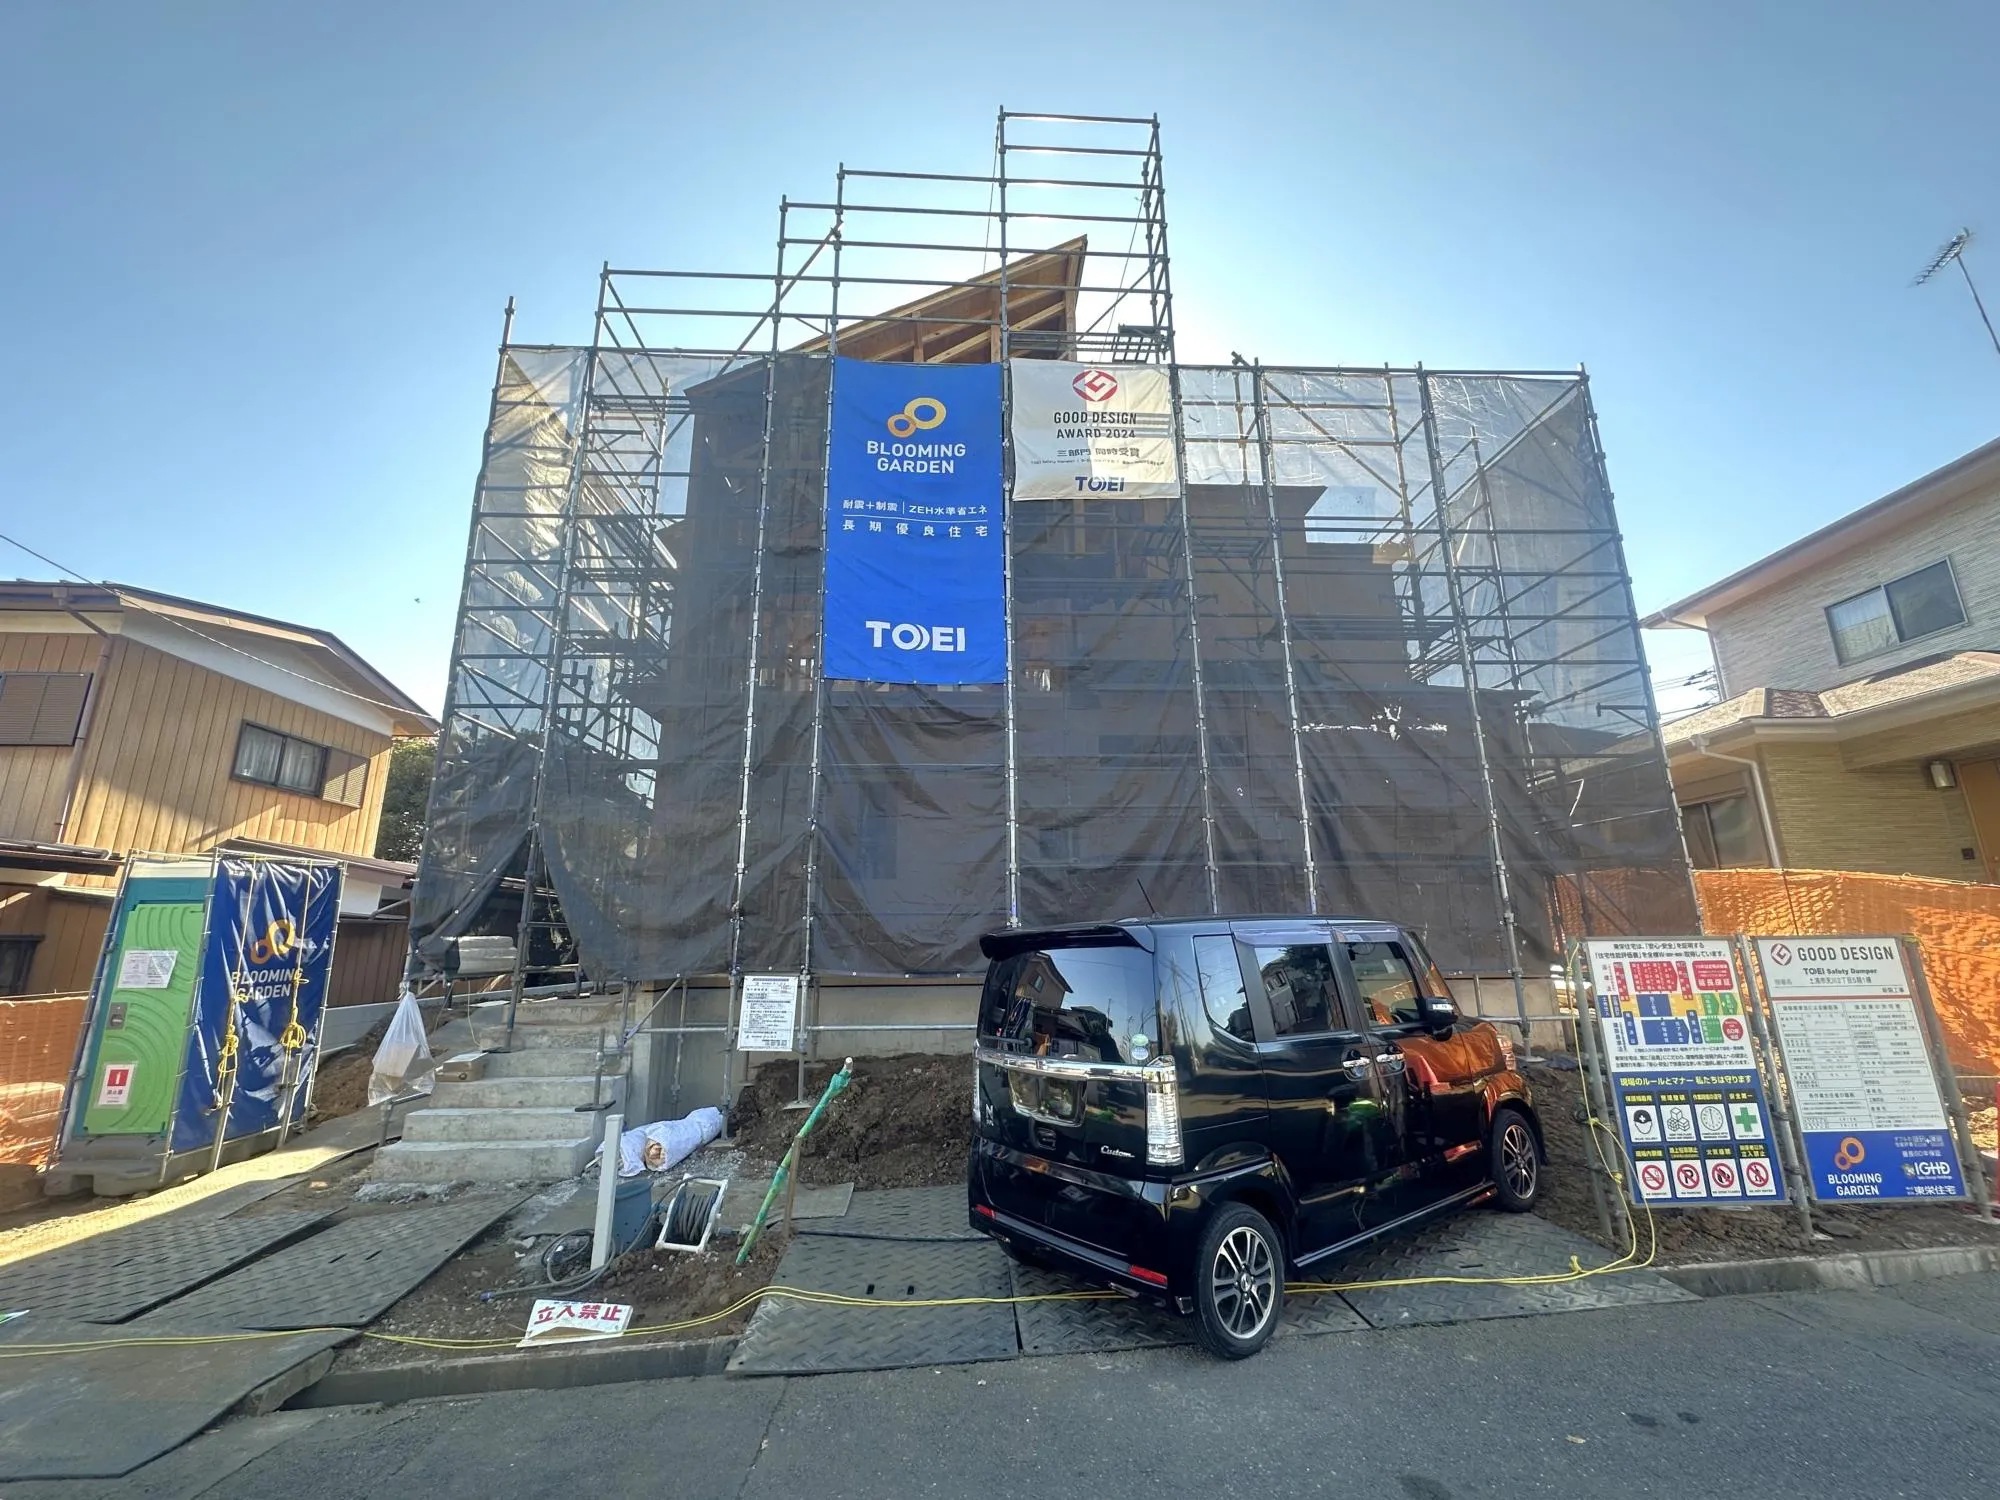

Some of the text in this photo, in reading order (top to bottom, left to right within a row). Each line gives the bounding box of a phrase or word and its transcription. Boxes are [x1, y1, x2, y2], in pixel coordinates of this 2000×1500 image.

[1054, 411, 1137, 425] GOOD DESIGN
[1056, 428, 1136, 439] AWARD 2024
[866, 440, 966, 458] BLOOMING
[877, 457, 955, 474] GARDEN
[1074, 476, 1125, 492] TOEI
[842, 519, 988, 538] 長期優良住宅
[865, 620, 966, 652] TOEI
[1798, 946, 1895, 961] GOOD DESIGN
[1100, 1145, 1135, 1158] Custom
[1827, 1172, 1882, 1185] BLOOMING
[1836, 1185, 1880, 1196] GARDEN
[534, 1304, 622, 1325] 立入禁止
